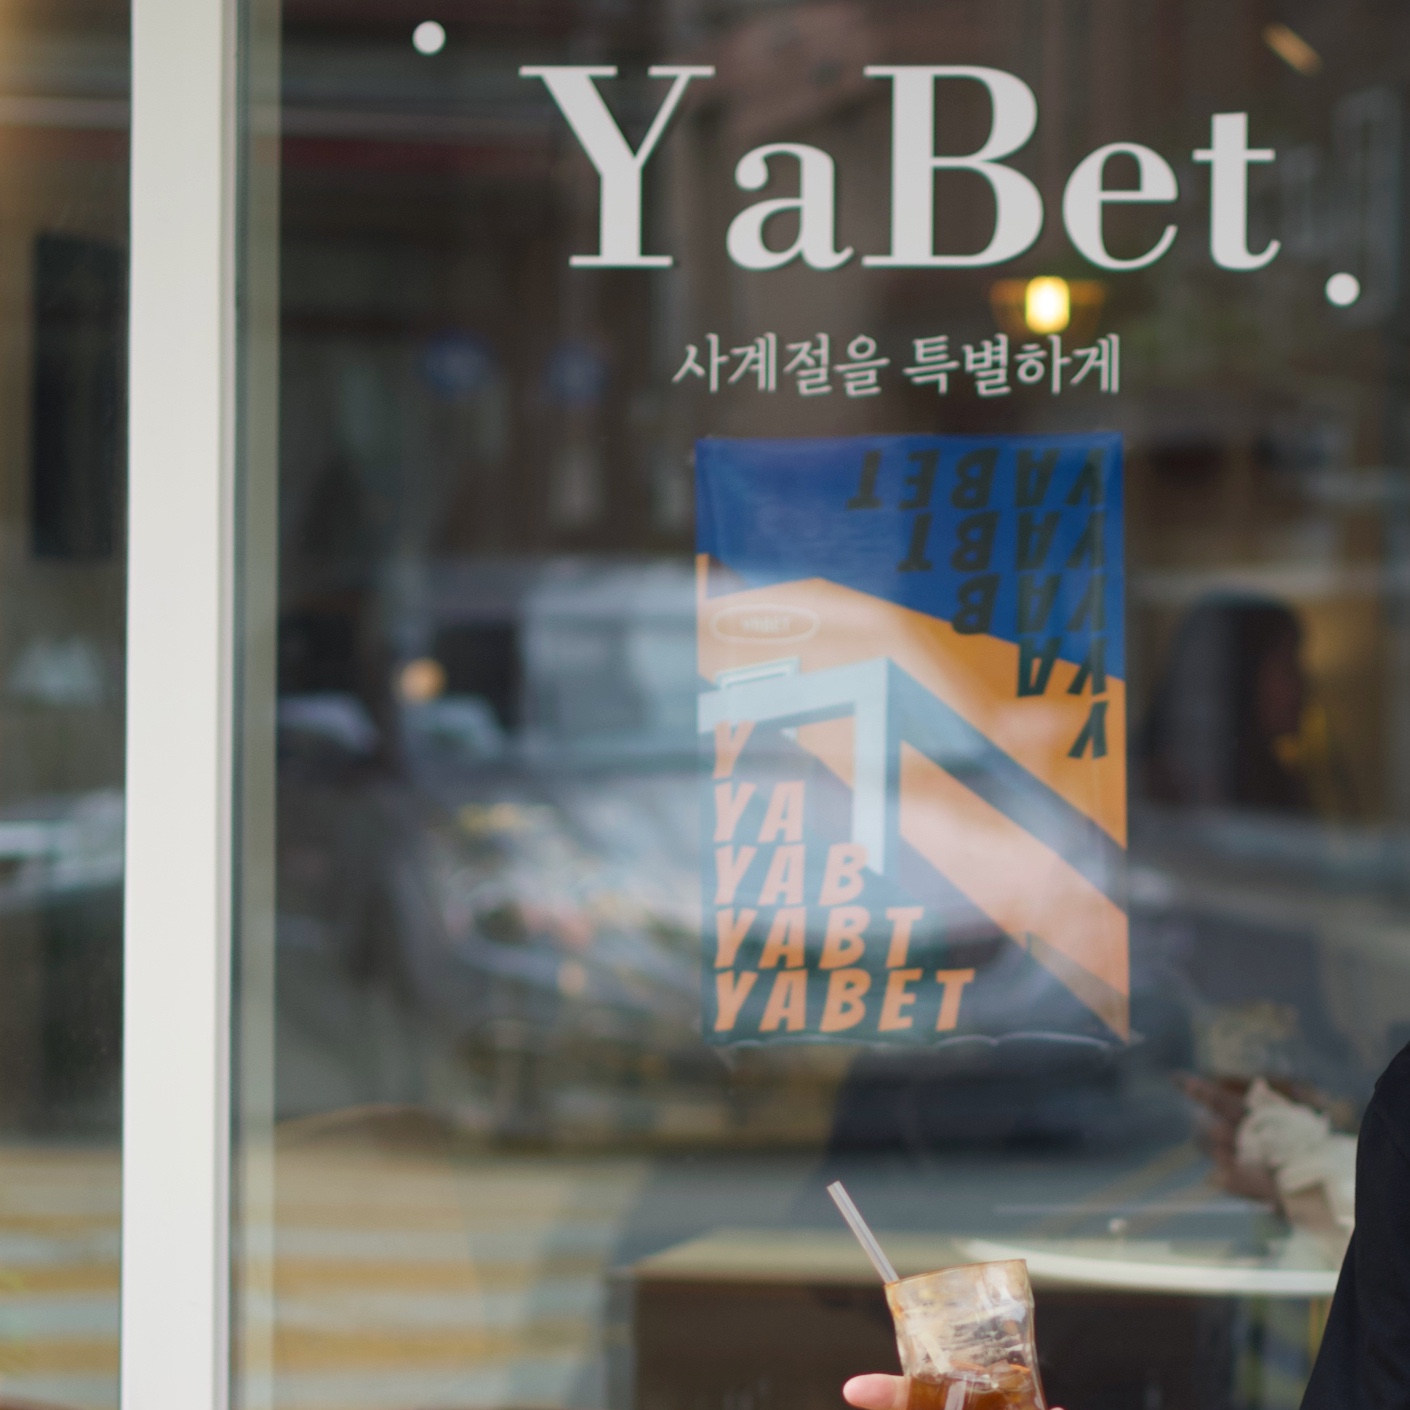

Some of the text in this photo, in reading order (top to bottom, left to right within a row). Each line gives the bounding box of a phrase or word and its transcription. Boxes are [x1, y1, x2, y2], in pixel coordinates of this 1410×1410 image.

[519, 65, 1281, 270] YaBet
[672, 332, 1123, 397] 사계절을 특별하게
[847, 448, 1108, 511] YABET
[713, 720, 756, 779] Y
[713, 780, 806, 844] YA
[713, 843, 869, 906] YAB
[713, 906, 925, 970] YABT
[713, 968, 976, 1032] YABET
